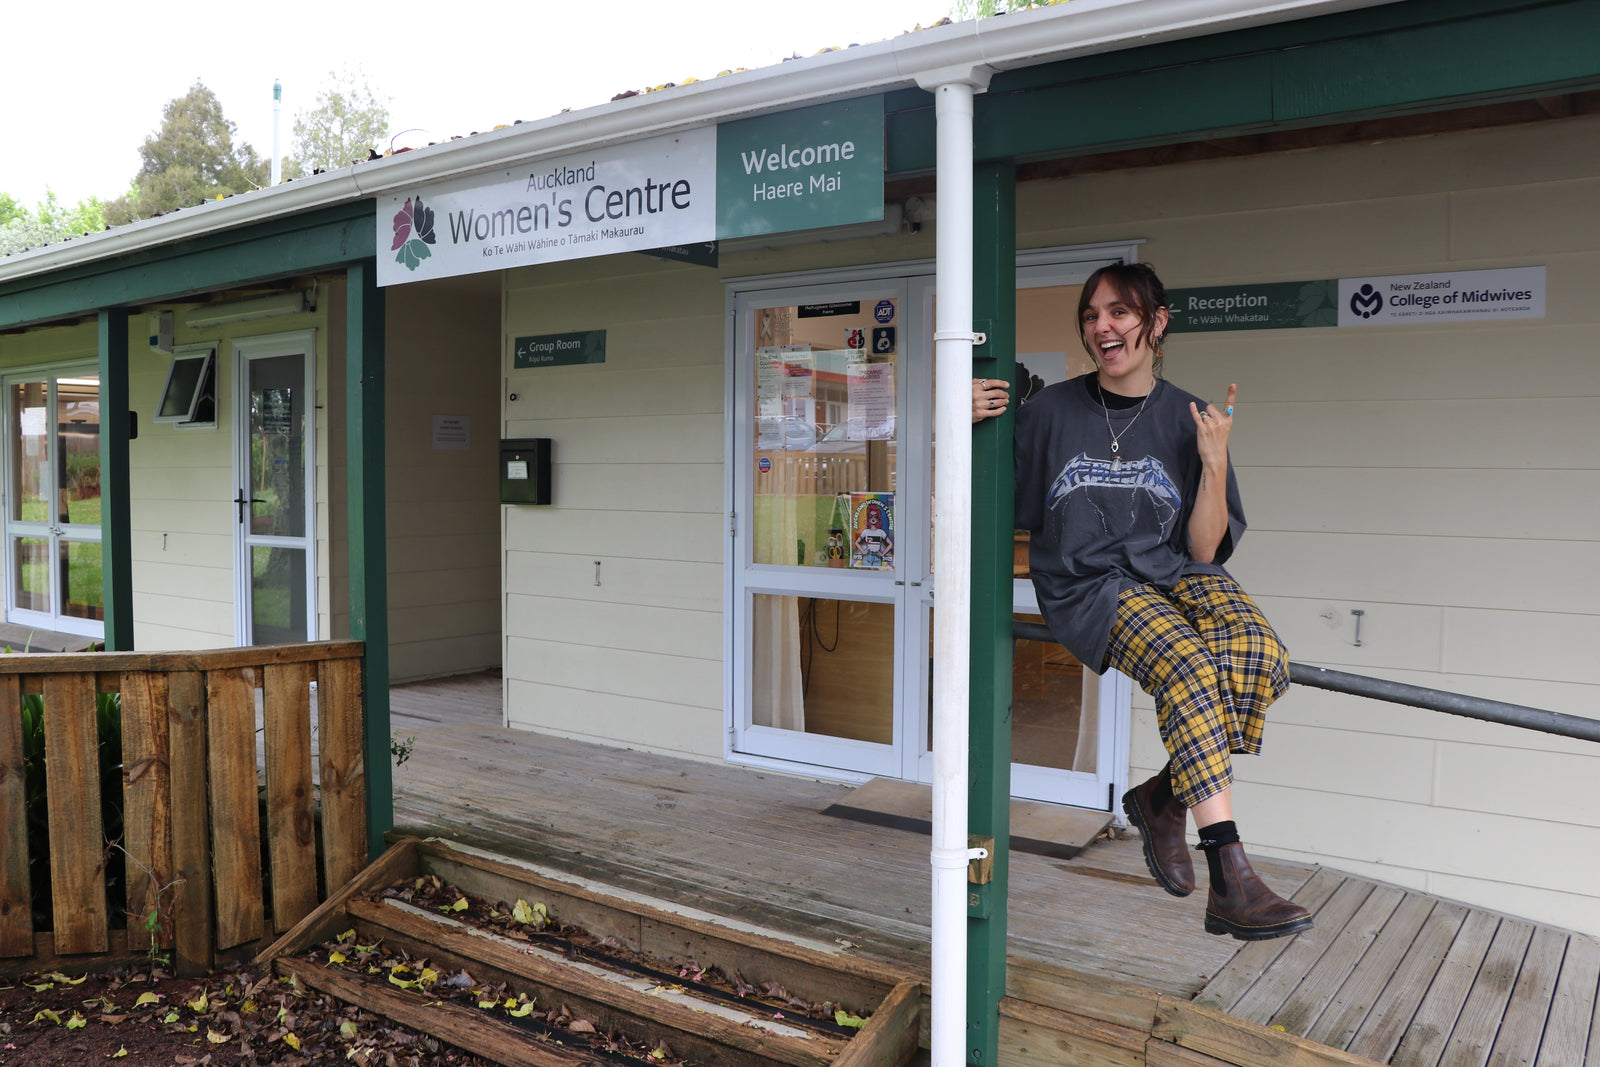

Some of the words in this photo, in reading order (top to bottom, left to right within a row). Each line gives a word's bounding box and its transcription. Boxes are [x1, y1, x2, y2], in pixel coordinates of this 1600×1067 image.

[741, 141, 855, 175] Welcome
[527, 160, 595, 192] Auckland
[753, 181, 803, 202] Haere
[809, 171, 841, 194] Mai
[449, 192, 572, 244] Women's
[584, 178, 691, 222] Centre
[482, 247, 493, 257] Ko
[494, 246, 504, 255] Te
[505, 240, 526, 254] Wāhi
[528, 237, 558, 250] Wāhine
[567, 230, 599, 244] Tāmaki
[601, 225, 644, 240] Makaurau
[1390, 283, 1411, 291] New
[1413, 280, 1451, 290] Zealand
[1188, 293, 1268, 313] Reception
[1389, 294, 1441, 309] College
[1443, 291, 1459, 304] of
[1462, 289, 1532, 303] Midwives
[877, 307, 892, 317] ADT
[1188, 316, 1198, 325] Te
[1224, 313, 1269, 323] Whakatau
[529, 341, 555, 354] Group
[556, 340, 581, 350] Room
